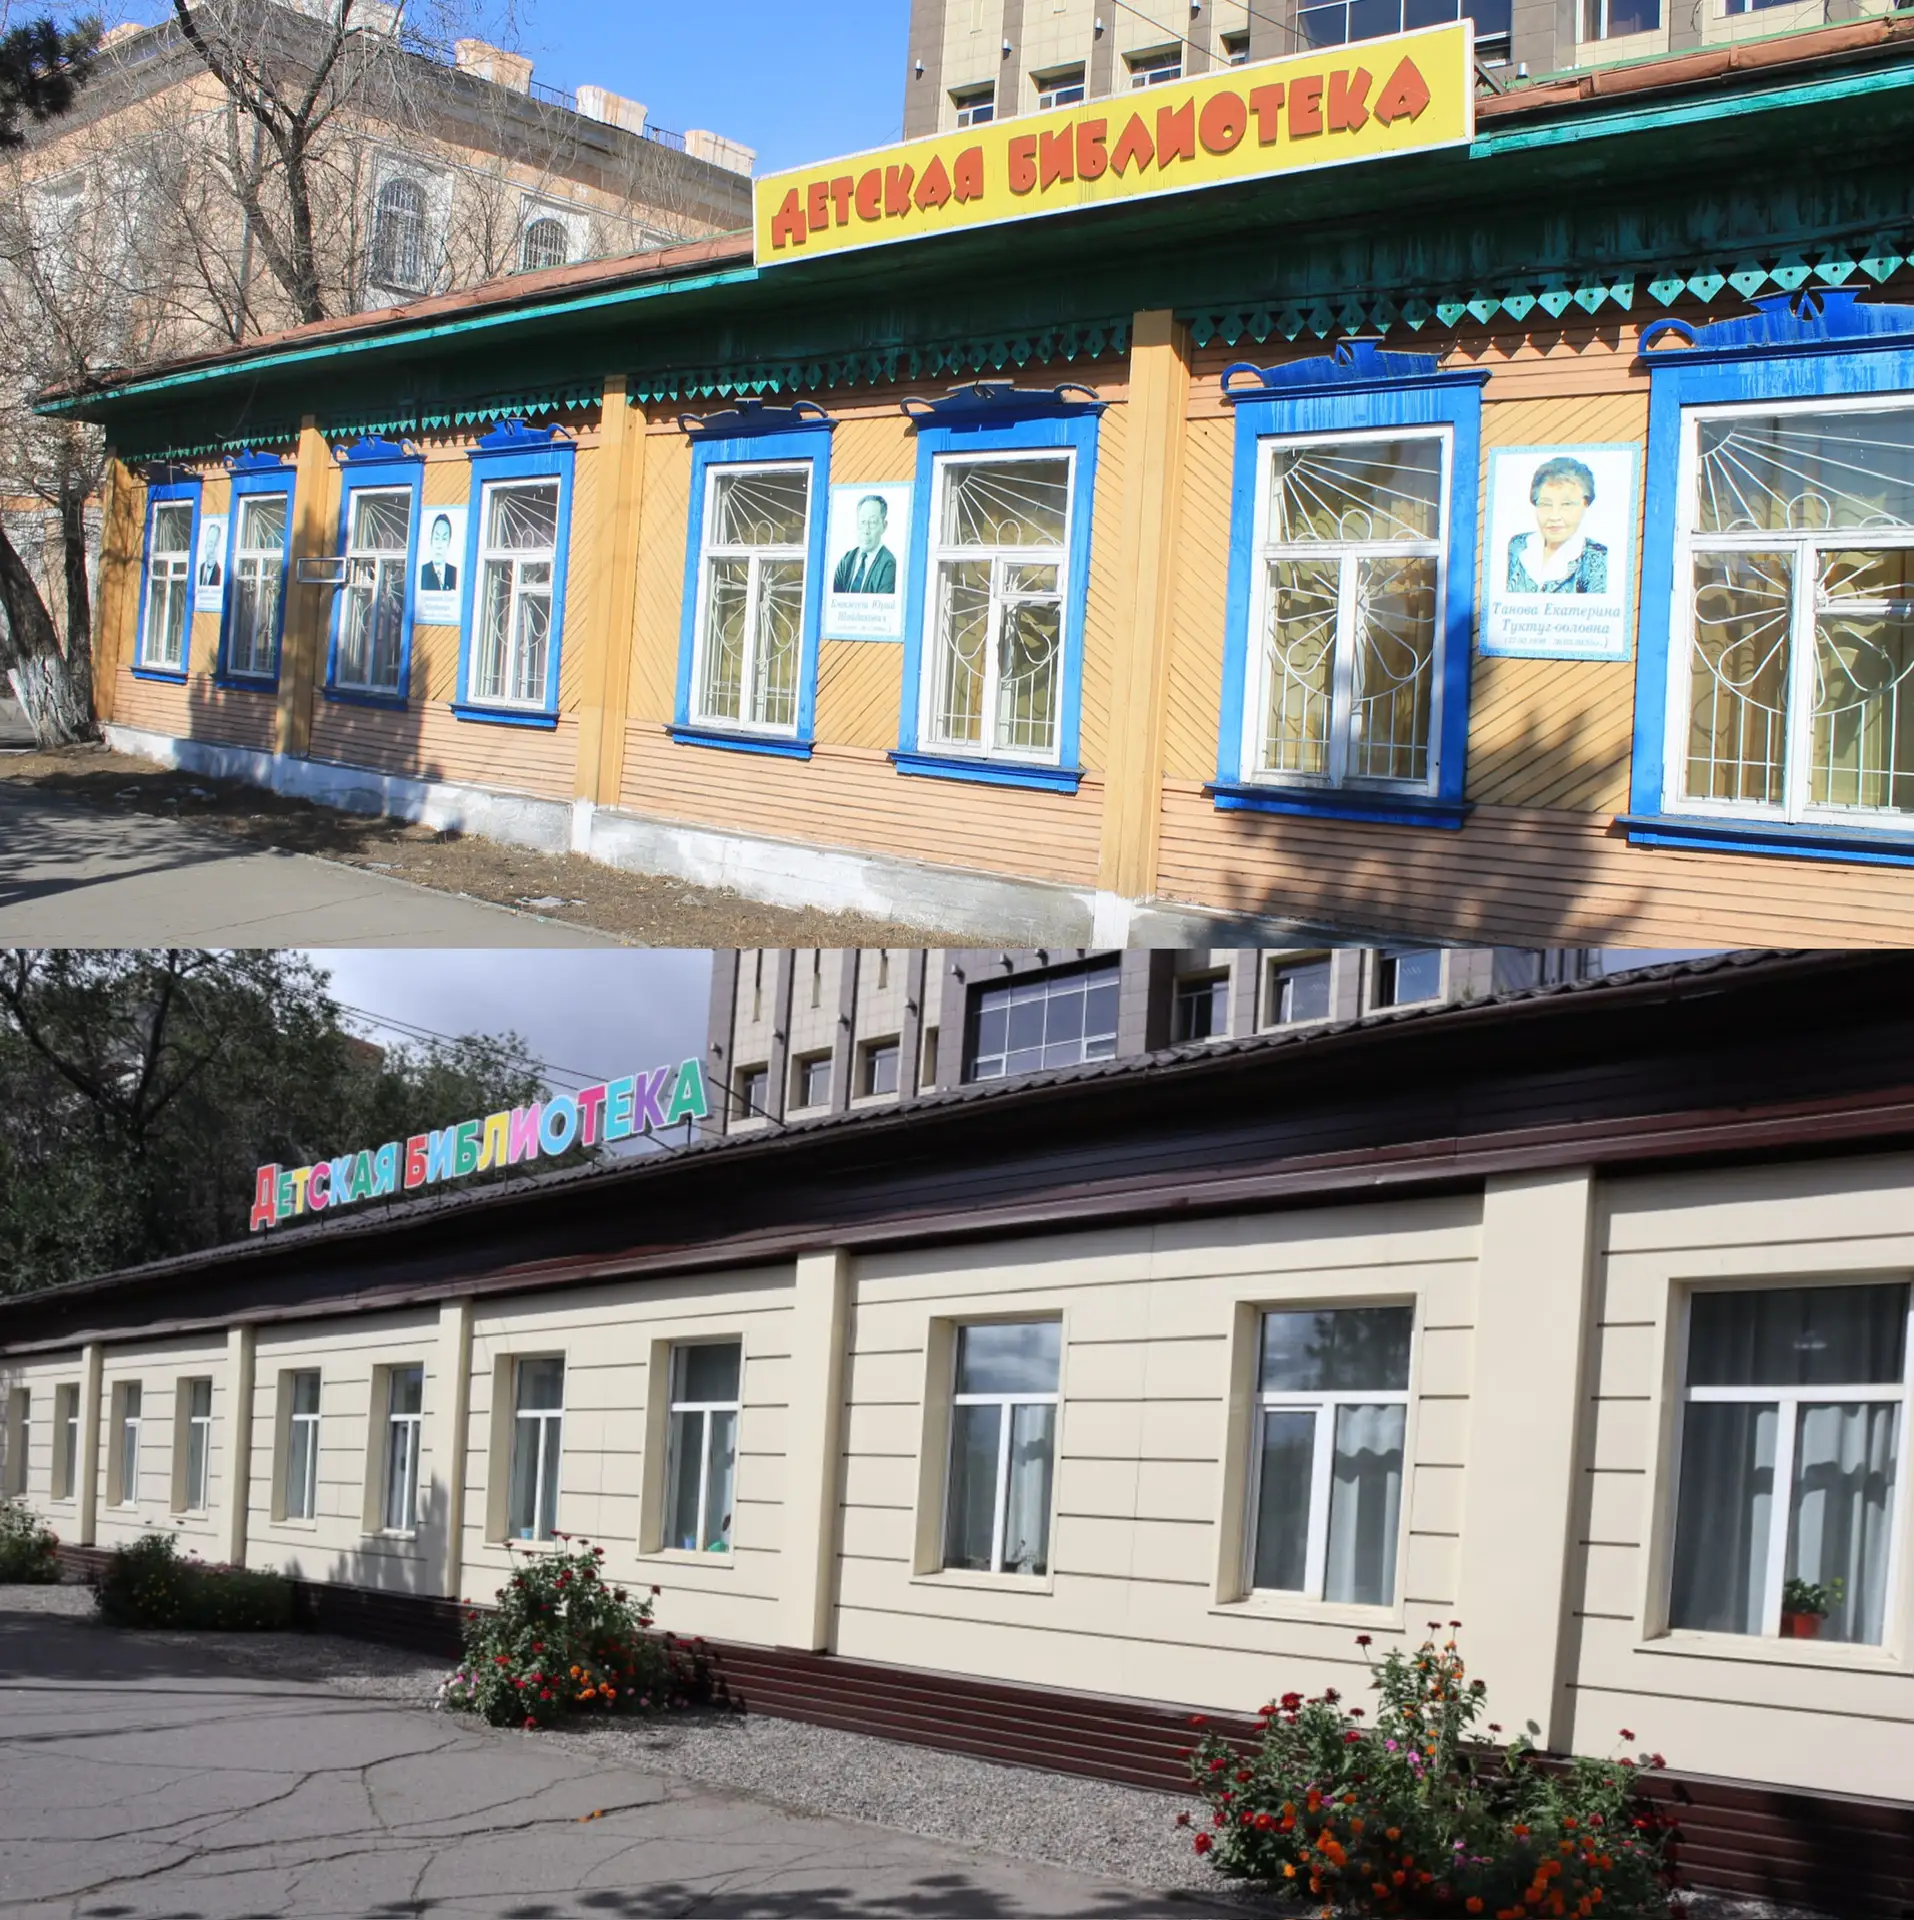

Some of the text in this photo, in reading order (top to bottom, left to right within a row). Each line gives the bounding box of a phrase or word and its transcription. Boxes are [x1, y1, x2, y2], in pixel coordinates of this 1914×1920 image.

[771, 54, 1432, 248] ДЕТСКАЯ БИБЛИОТЕКА
[1492, 601, 1621, 620] Танова Екатерина
[250, 1057, 708, 1232] ДЕТСКАЯ БИБЛИОТЕКА
